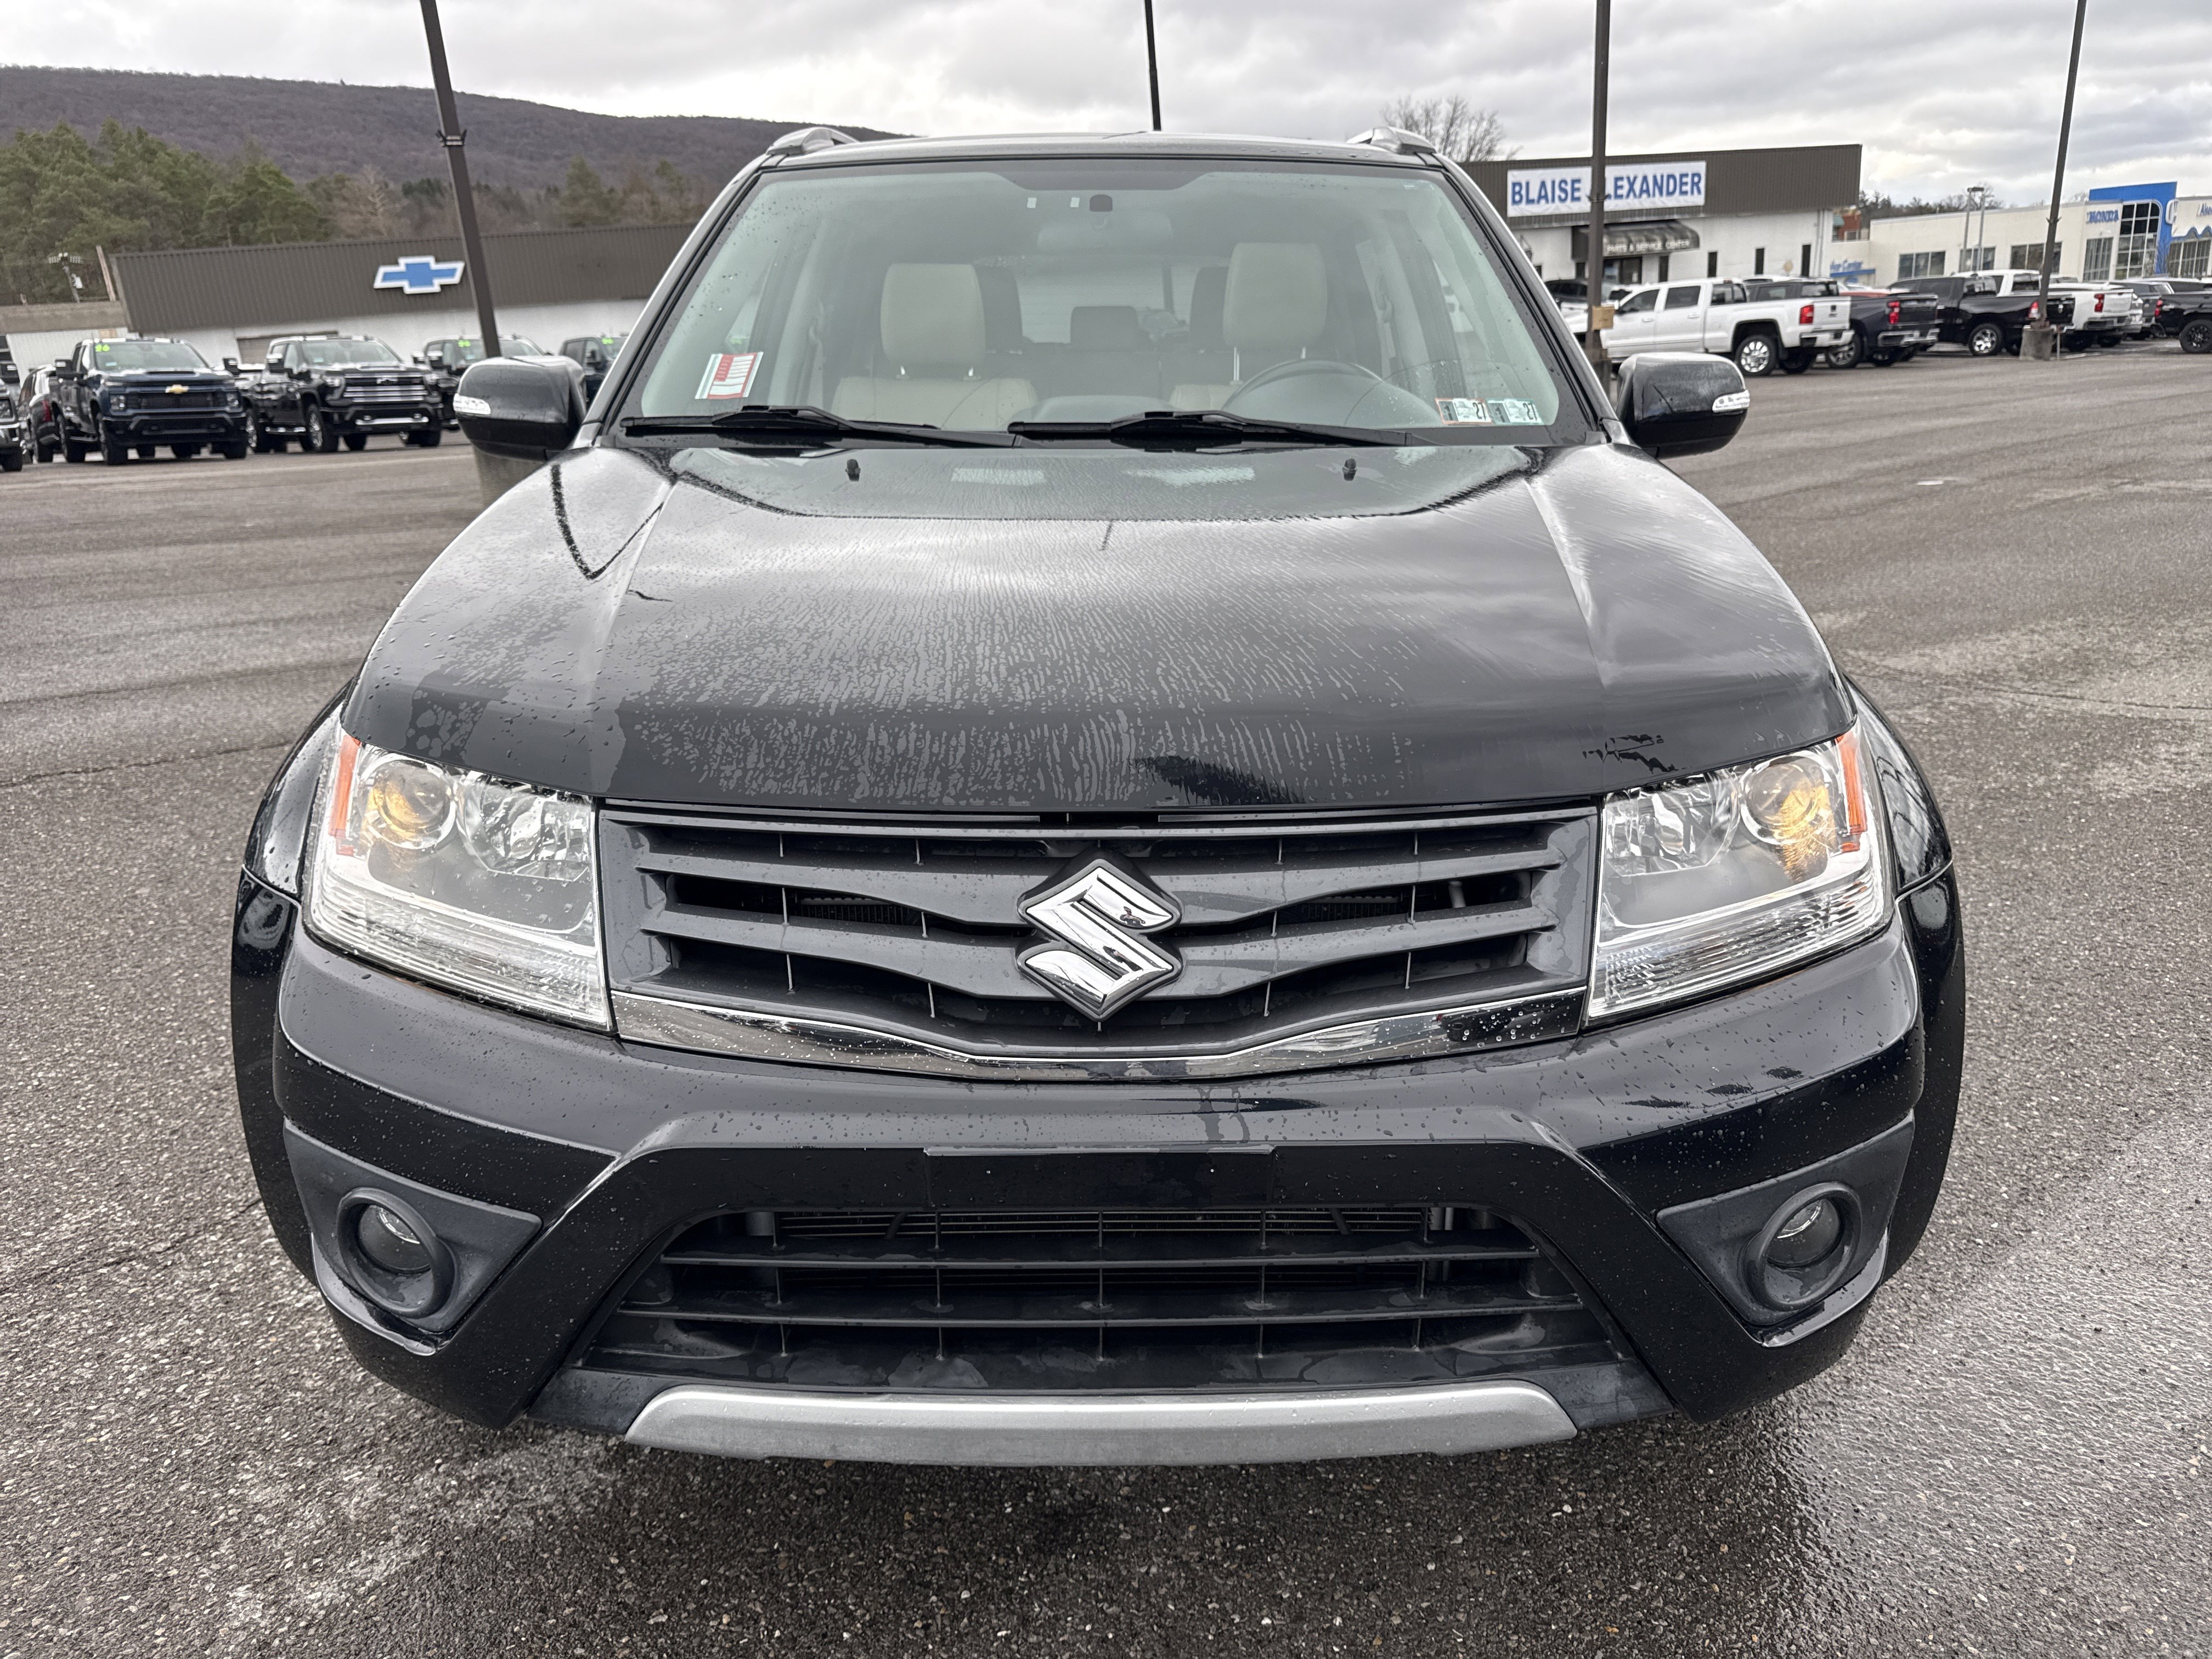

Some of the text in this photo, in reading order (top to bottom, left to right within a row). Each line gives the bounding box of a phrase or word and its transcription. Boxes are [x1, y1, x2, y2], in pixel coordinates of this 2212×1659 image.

[1511, 172, 1701, 206] BLAISE EXANDER
[1472, 402, 1486, 420] 27
[1523, 403, 1537, 420] 27
